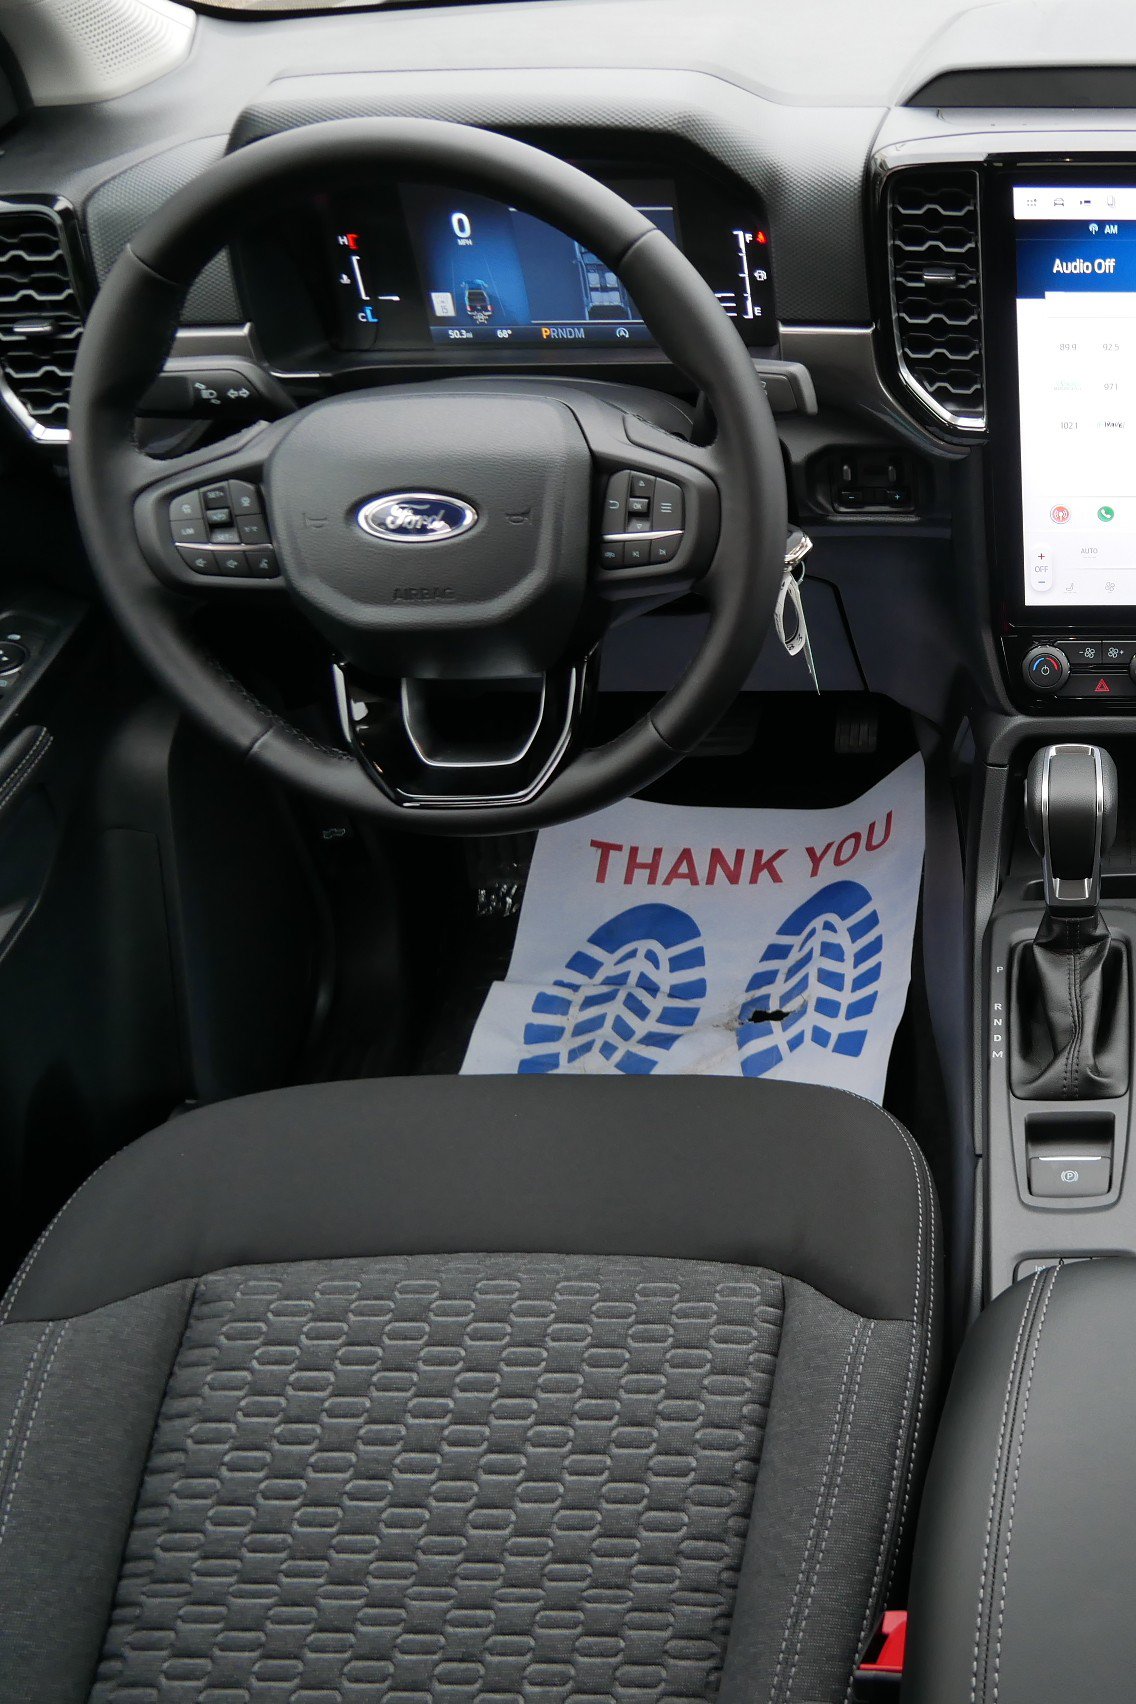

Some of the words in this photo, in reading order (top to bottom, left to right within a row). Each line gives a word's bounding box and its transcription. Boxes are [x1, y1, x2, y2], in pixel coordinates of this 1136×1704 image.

[451, 212, 472, 238] 0
[1104, 224, 1118, 235] AM
[338, 235, 348, 245] H
[457, 238, 473, 246] MPH
[744, 233, 753, 243] F
[1052, 258, 1093, 274] Audio
[1093, 258, 1117, 274] Off
[754, 306, 762, 316] E
[358, 312, 367, 322] C
[385, 503, 446, 530] Ford
[1080, 547, 1099, 555] AUTO
[1034, 565, 1049, 573] OFF
[589, 839, 789, 886] THANK
[804, 809, 893, 878] YOU
[993, 1018, 1003, 1026] N
[993, 1034, 1002, 1042] D
[992, 1050, 1003, 1058] M
